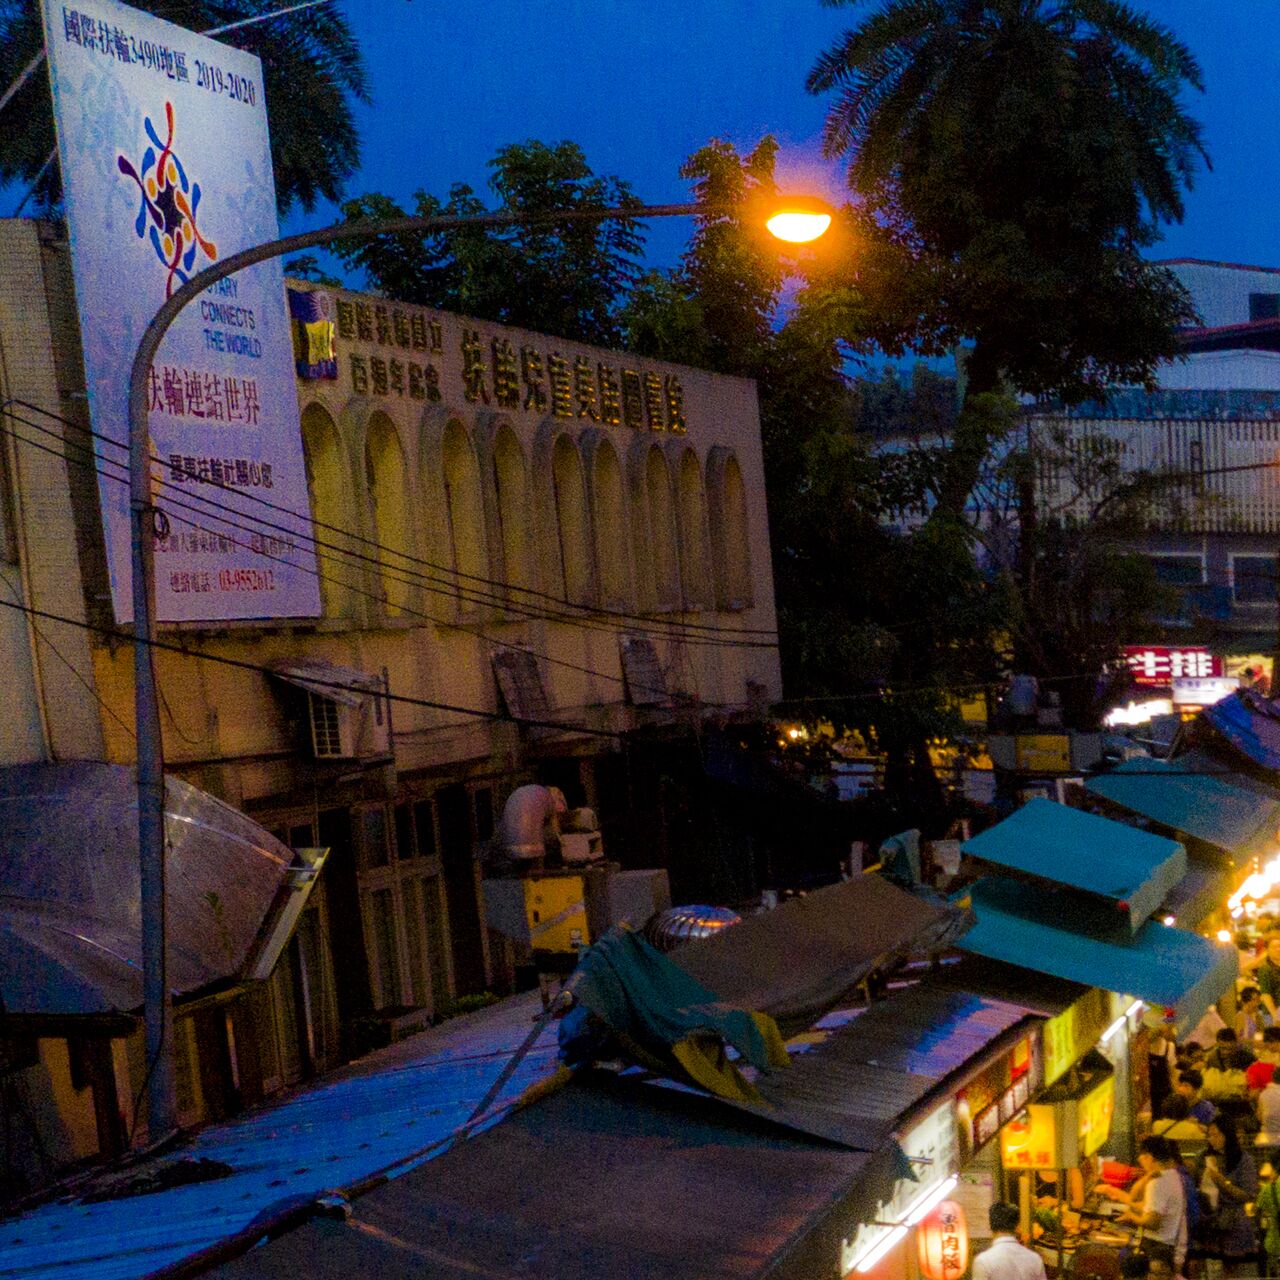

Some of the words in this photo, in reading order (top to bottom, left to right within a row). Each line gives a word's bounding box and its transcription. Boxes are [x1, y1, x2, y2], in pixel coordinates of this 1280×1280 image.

[194, 59, 257, 107] 2019-2020
[201, 300, 255, 330] CONNECTS
[203, 328, 225, 352] THE
[225, 333, 262, 359] WORLD
[1131, 651, 1212, 678] 牛排
